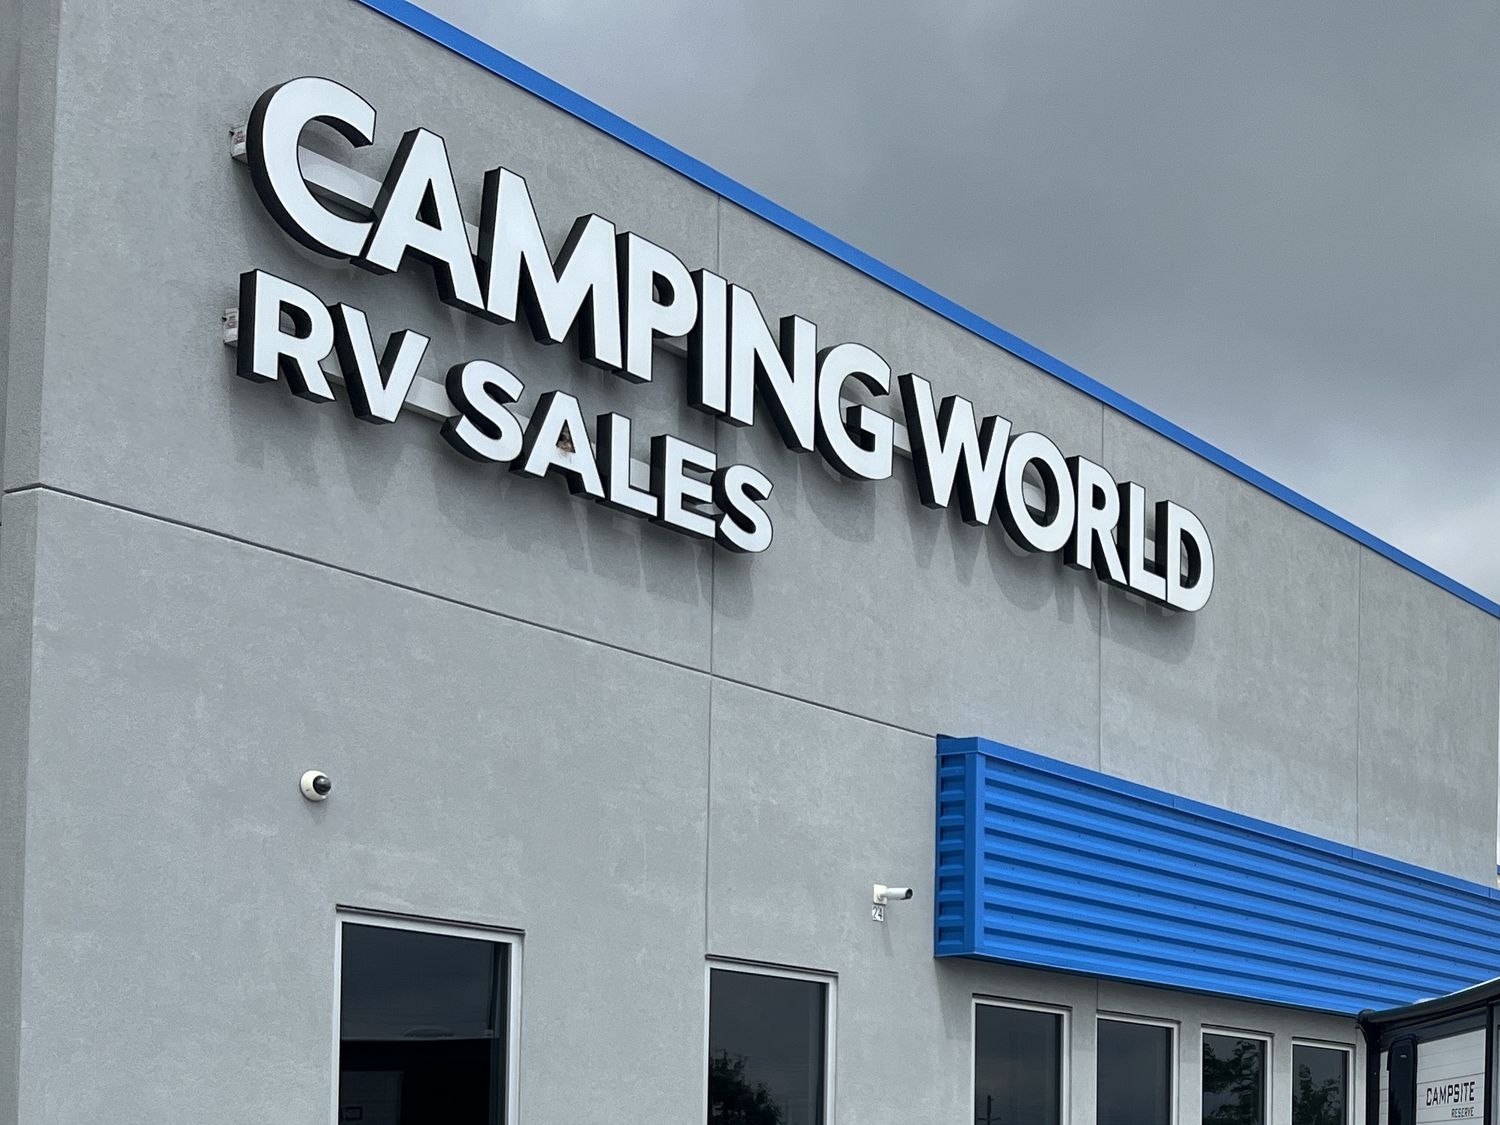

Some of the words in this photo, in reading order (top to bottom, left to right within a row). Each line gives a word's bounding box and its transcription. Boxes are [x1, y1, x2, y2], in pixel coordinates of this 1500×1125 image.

[239, 270, 430, 424] RV
[441, 360, 773, 554] SALES
[248, 76, 894, 480] CAMPING
[900, 373, 1215, 613] WORLD
[1426, 1081, 1476, 1107] CAMPSITE
[1451, 1106, 1475, 1118] RESERVE
